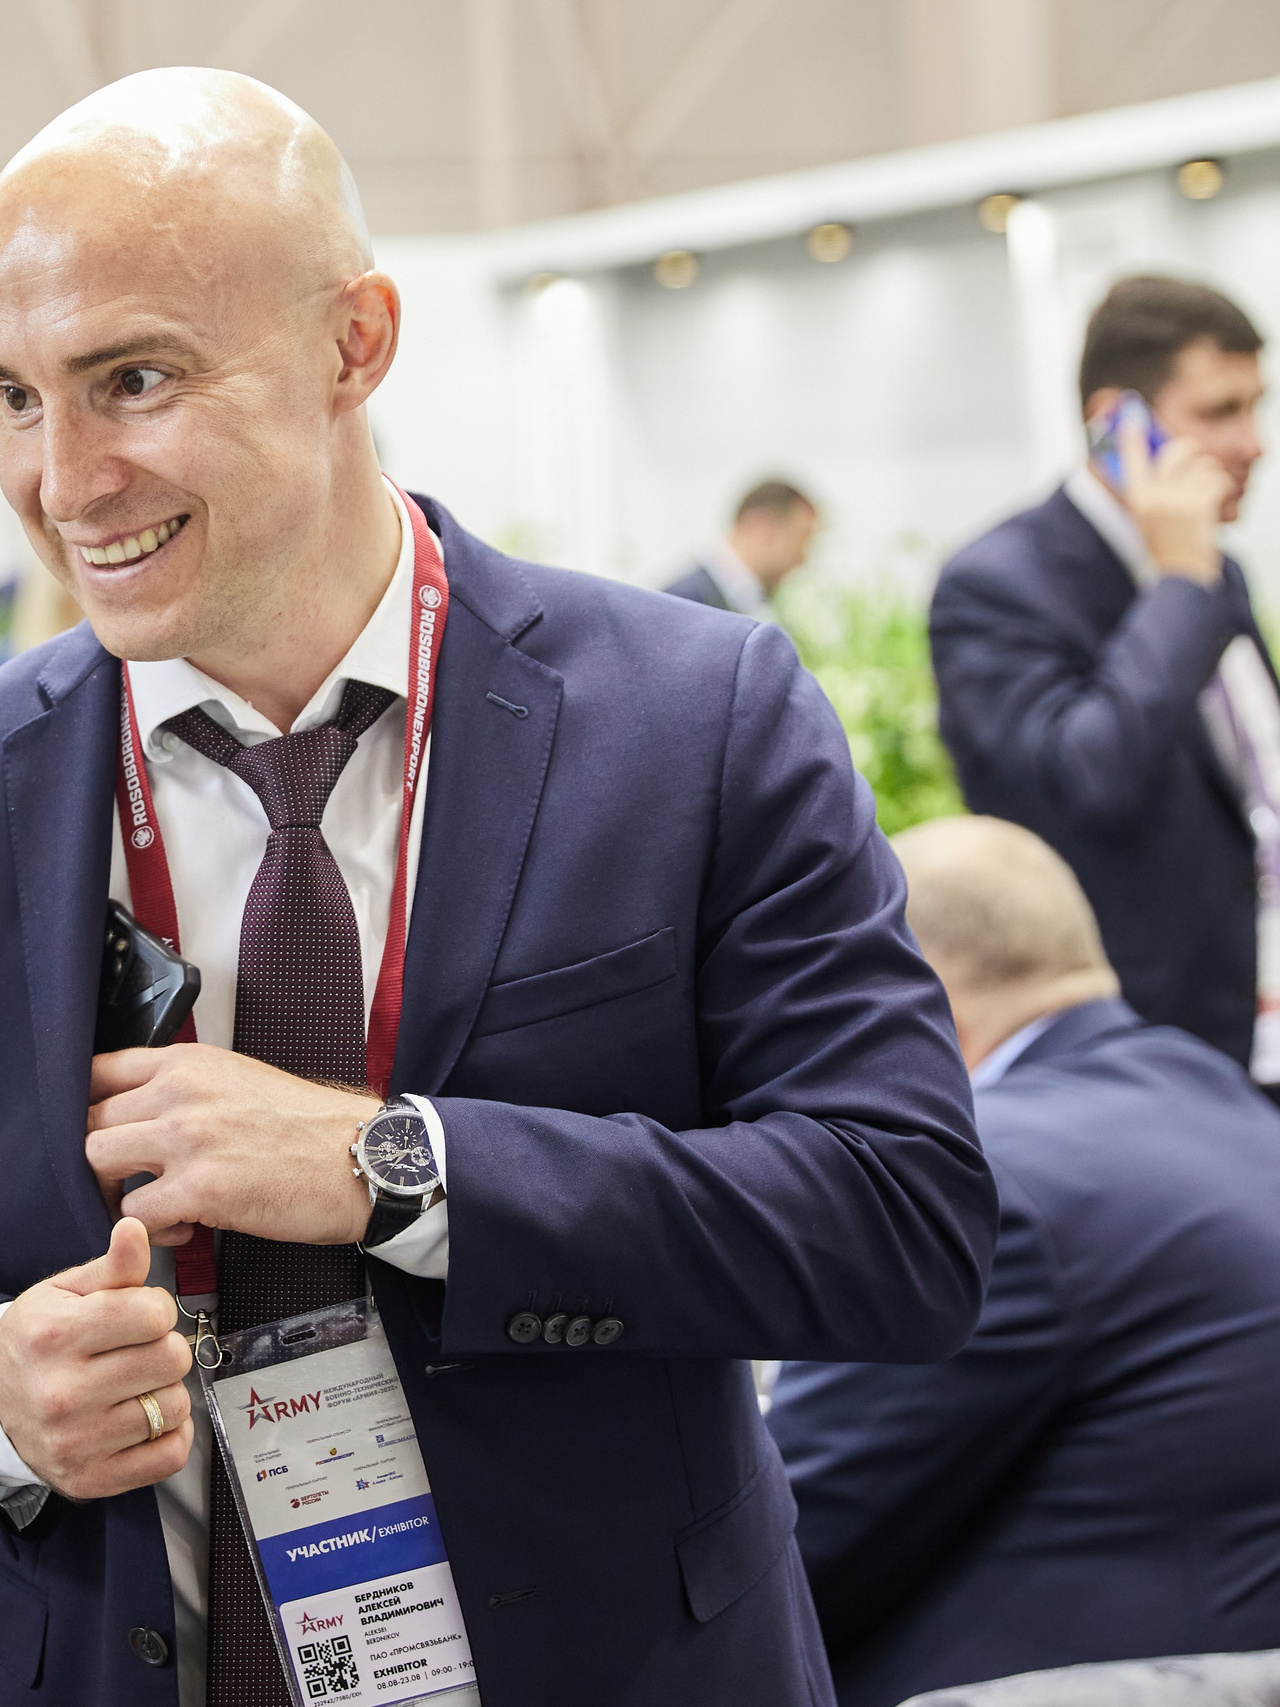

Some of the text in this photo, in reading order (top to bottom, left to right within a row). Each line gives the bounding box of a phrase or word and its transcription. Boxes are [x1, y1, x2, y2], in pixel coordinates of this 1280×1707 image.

[406, 608, 436, 793] ROSOBORONEXPORT
[323, 1372, 385, 1395] МЕЖДУНАРОДНЫЙ
[325, 1376, 399, 1402] ВОЕННО-ТЕХНИЧЕСКИЙ
[327, 1396, 352, 1409] ФОРУМ
[268, 1465, 289, 1478] ПСБ
[300, 1489, 329, 1502] ВЕРТОЛЕТЫ
[301, 1497, 322, 1507] РОССИИ
[354, 1581, 415, 1604] БЕРДНИКОВ
[358, 1595, 402, 1615] АЛЕКСЕЙ
[360, 1597, 445, 1626] ВЛАДИМИРОВИЧ
[364, 1626, 387, 1638] ALEKSEI
[366, 1631, 401, 1646] BERDNIKOV
[370, 1633, 463, 1662] ПАО «ПРОМСВЯЗЬБАНК»
[373, 1658, 429, 1680] EXHIBITOR
[376, 1673, 422, 1691] 08.08-23.08
[431, 1665, 453, 1677] 09:00
